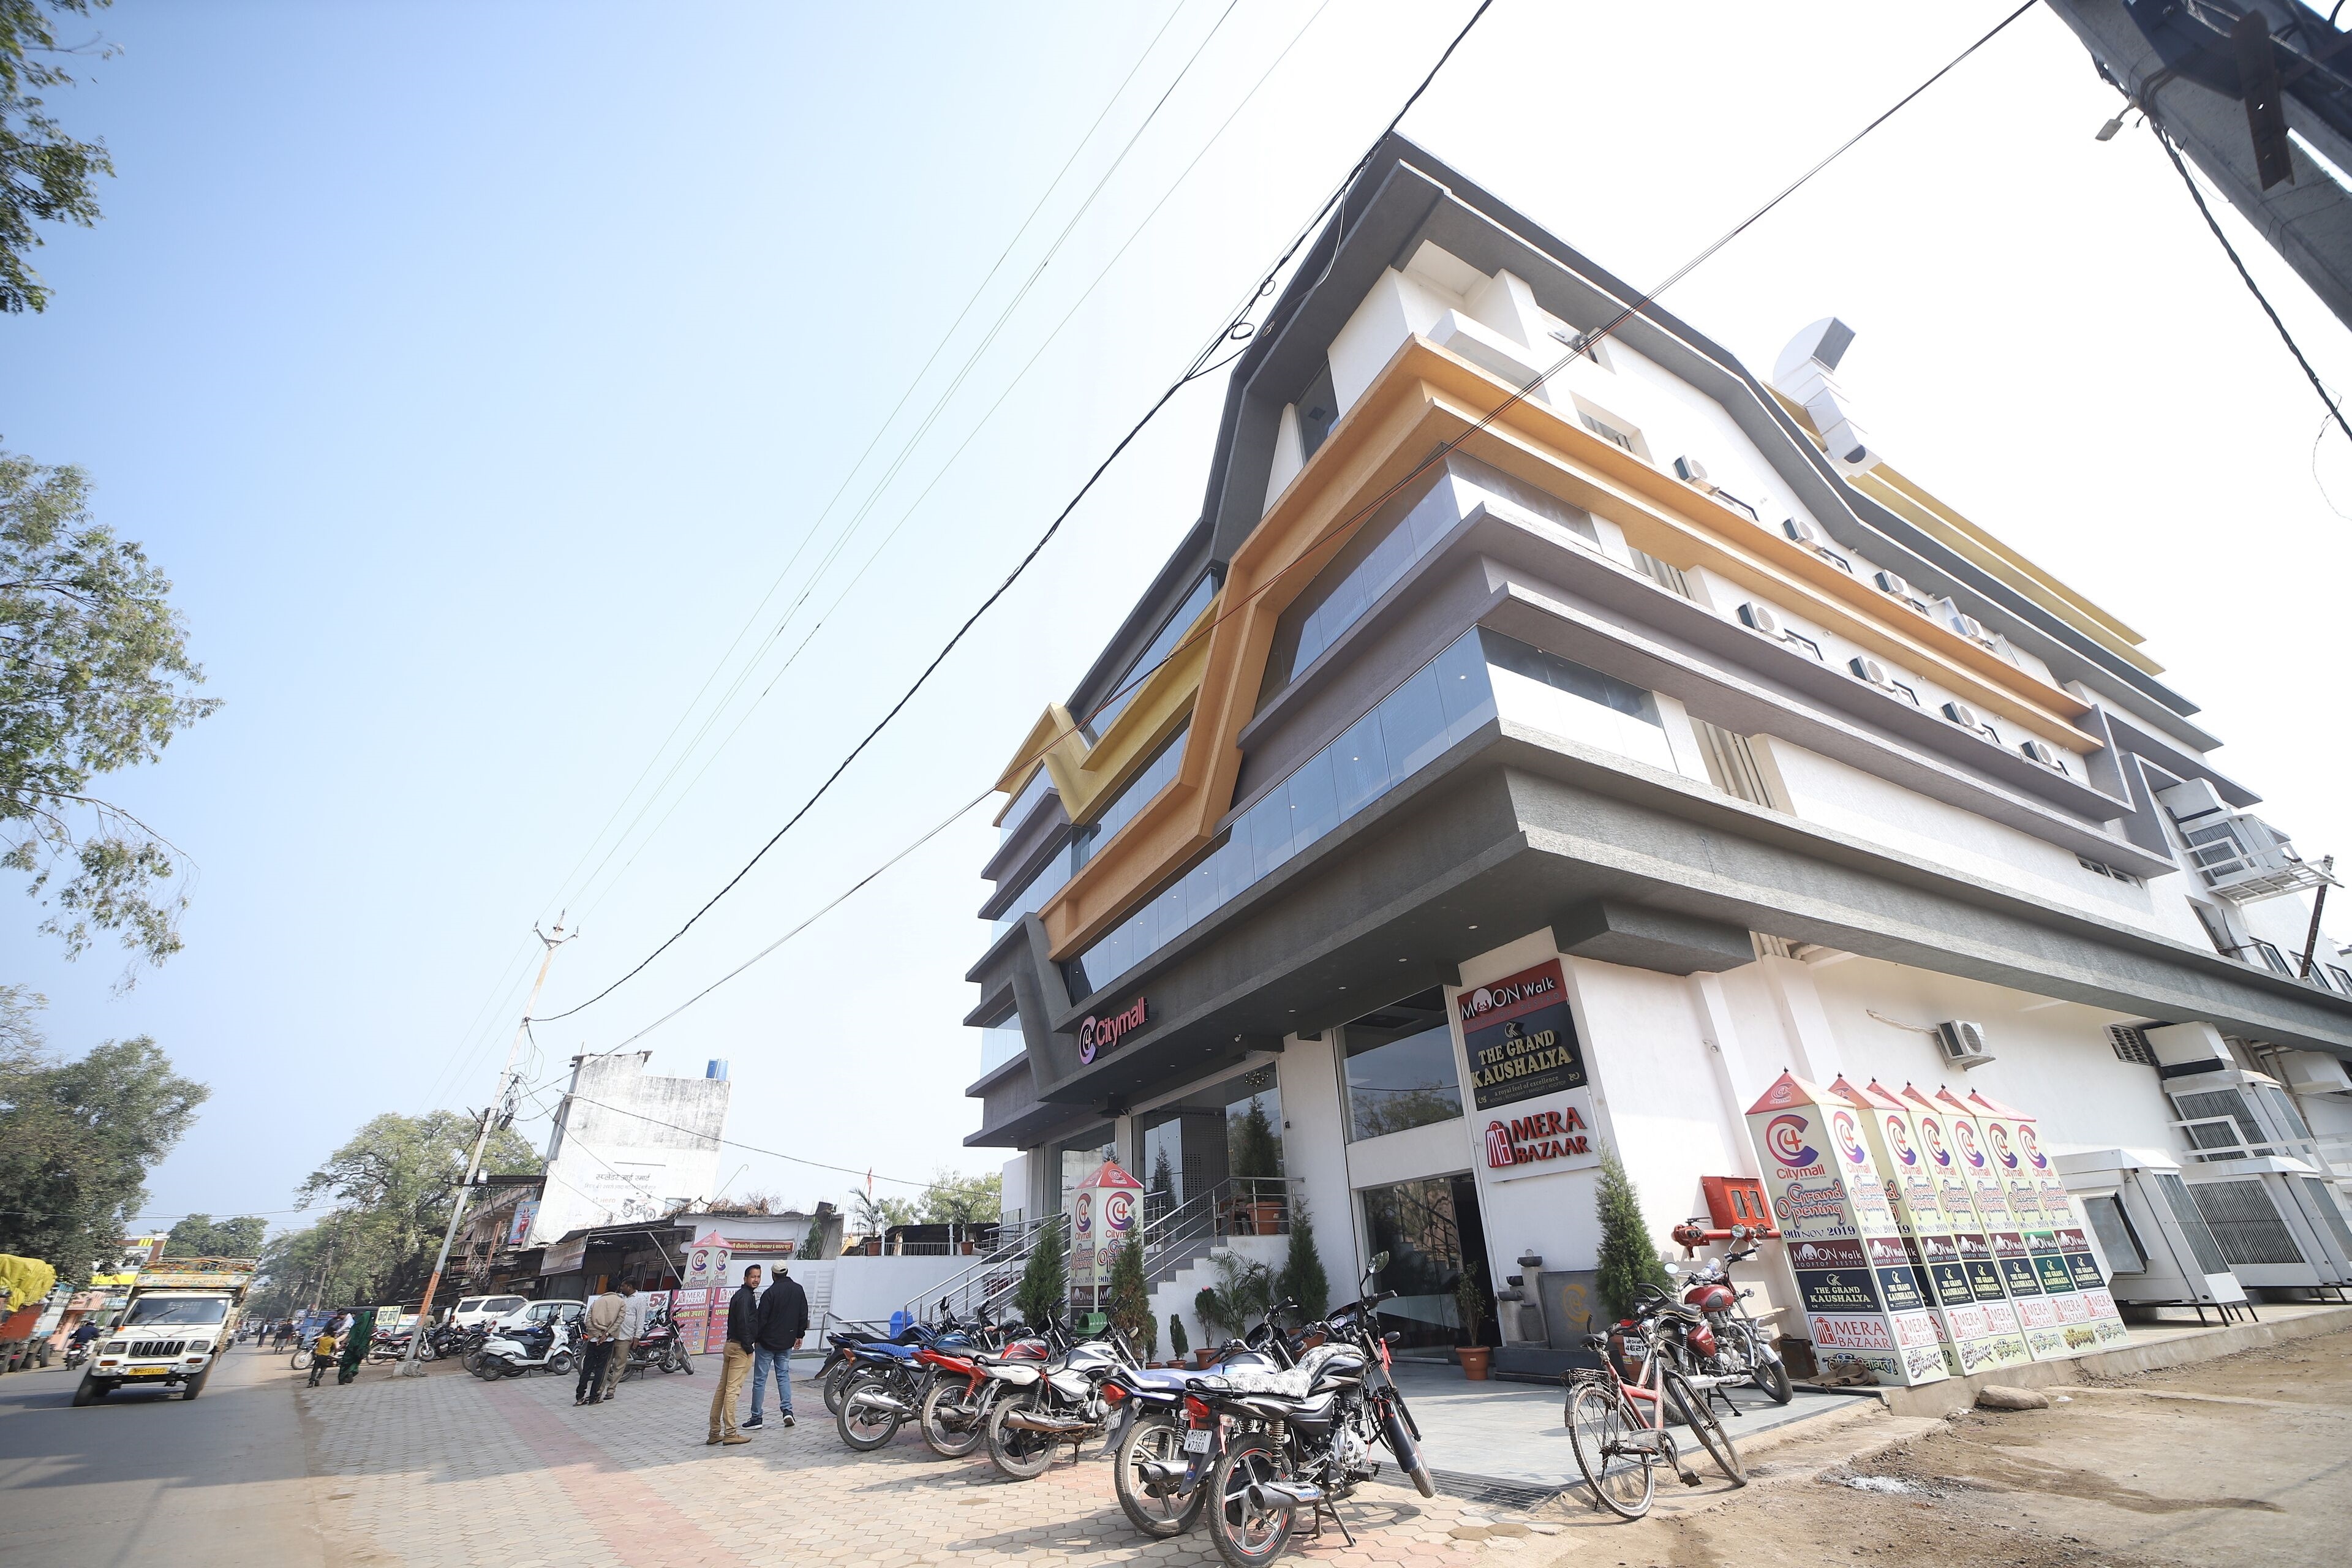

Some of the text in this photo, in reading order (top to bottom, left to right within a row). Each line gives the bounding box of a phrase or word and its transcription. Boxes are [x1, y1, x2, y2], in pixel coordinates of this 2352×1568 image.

[1523, 977, 1555, 998] Walk
[1096, 997, 1145, 1047] Citymall
[1478, 1029, 1555, 1065] THE GRAND
[1470, 1046, 1572, 1088] KAUSHALYA
[1498, 1087, 1512, 1096] royal
[1512, 1084, 1523, 1093] feel
[1530, 1076, 1559, 1088] excellence
[1510, 1107, 1588, 1143] MERA
[1515, 1136, 1593, 1164] BAZAAR
[1776, 1164, 1825, 1180] Citymall
[1845, 1163, 1871, 1176] Citymall
[1900, 1164, 1923, 1177] Citymall
[1934, 1164, 1957, 1178] Citymall
[1969, 1166, 1991, 1178] Citymall
[2002, 1168, 2024, 1180] Citymall
[2032, 1168, 2054, 1180] Citymall
[1788, 1180, 1845, 1205] Grand
[1776, 1197, 1845, 1227] Opening
[1075, 1231, 1091, 1242] Citymall
[1784, 1229, 1801, 1239] 9th
[1827, 1226, 1856, 1236] 2019
[1076, 1242, 1095, 1258] Grand
[1838, 1249, 1863, 1261] Walk
[2043, 1276, 2070, 1286] KAUSHALYA
[2075, 1273, 2100, 1281] KAUSHALYA
[1974, 1283, 2000, 1292] KAUSHALYA
[2010, 1279, 2037, 1289] KAUSHALYA
[1809, 1294, 1871, 1303] KAUSHALYA
[1887, 1291, 1917, 1302] KAUSHALYA
[1941, 1287, 1969, 1297] KAUSHALYA
[2060, 1300, 2081, 1313] MERA
[2092, 1294, 2113, 1307] MERA
[1991, 1306, 2011, 1321] MERA
[2026, 1302, 2049, 1316] MERA
[2096, 1307, 2119, 1318] BAZAAR
[1958, 1311, 1981, 1329] MERA
[2031, 1316, 2053, 1328] BAZAAR
[2065, 1313, 2086, 1324] BAZAAR
[1834, 1321, 1887, 1336] MERA
[1905, 1317, 1930, 1334] MERA
[1996, 1322, 2016, 1333] BAZAAR
[1909, 1333, 1934, 1346] BAZAAR
[1963, 1327, 1985, 1339] BAZAAR
[1838, 1337, 1892, 1349] BAZAAR
[1190, 1430, 1207, 1441] MP05M
[1188, 1441, 1204, 1452] W7360
